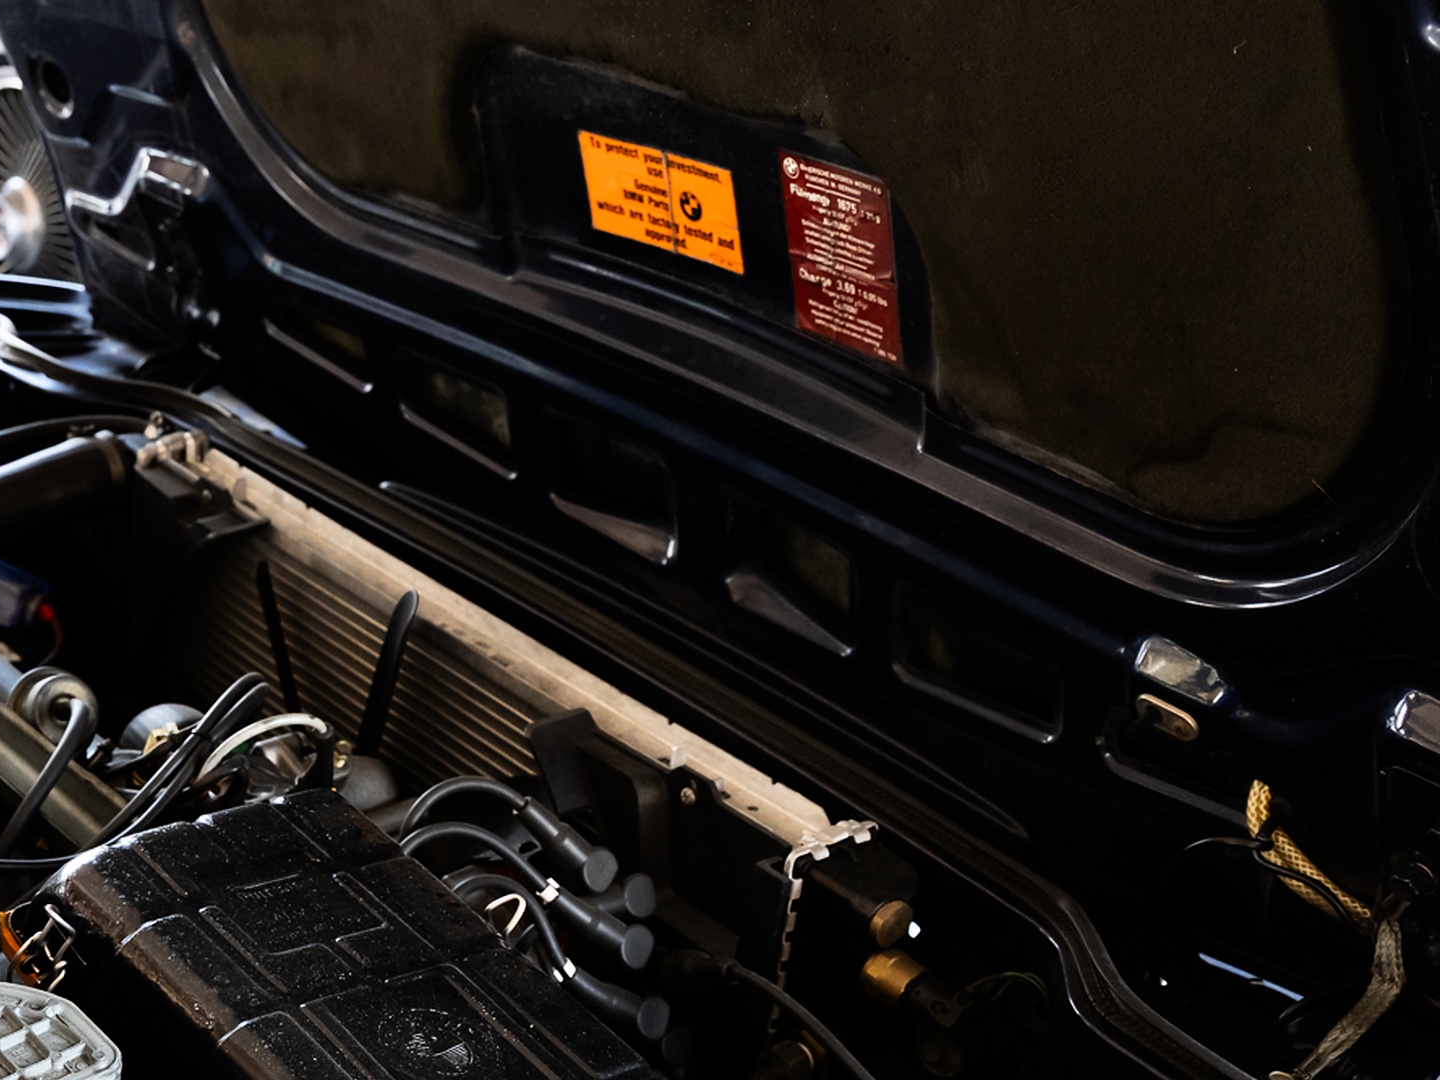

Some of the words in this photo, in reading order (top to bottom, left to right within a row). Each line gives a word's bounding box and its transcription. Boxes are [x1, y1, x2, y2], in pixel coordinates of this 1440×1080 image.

[589, 136, 602, 149] To
[605, 142, 639, 159] protect
[647, 166, 664, 179] use
[634, 179, 669, 198] Genuine
[623, 189, 644, 204] BMW
[647, 197, 670, 212] Parts
[597, 200, 625, 216] which
[629, 209, 644, 221] are
[683, 225, 713, 244] tested
[717, 236, 735, 251] and
[799, 266, 833, 287] Charge
